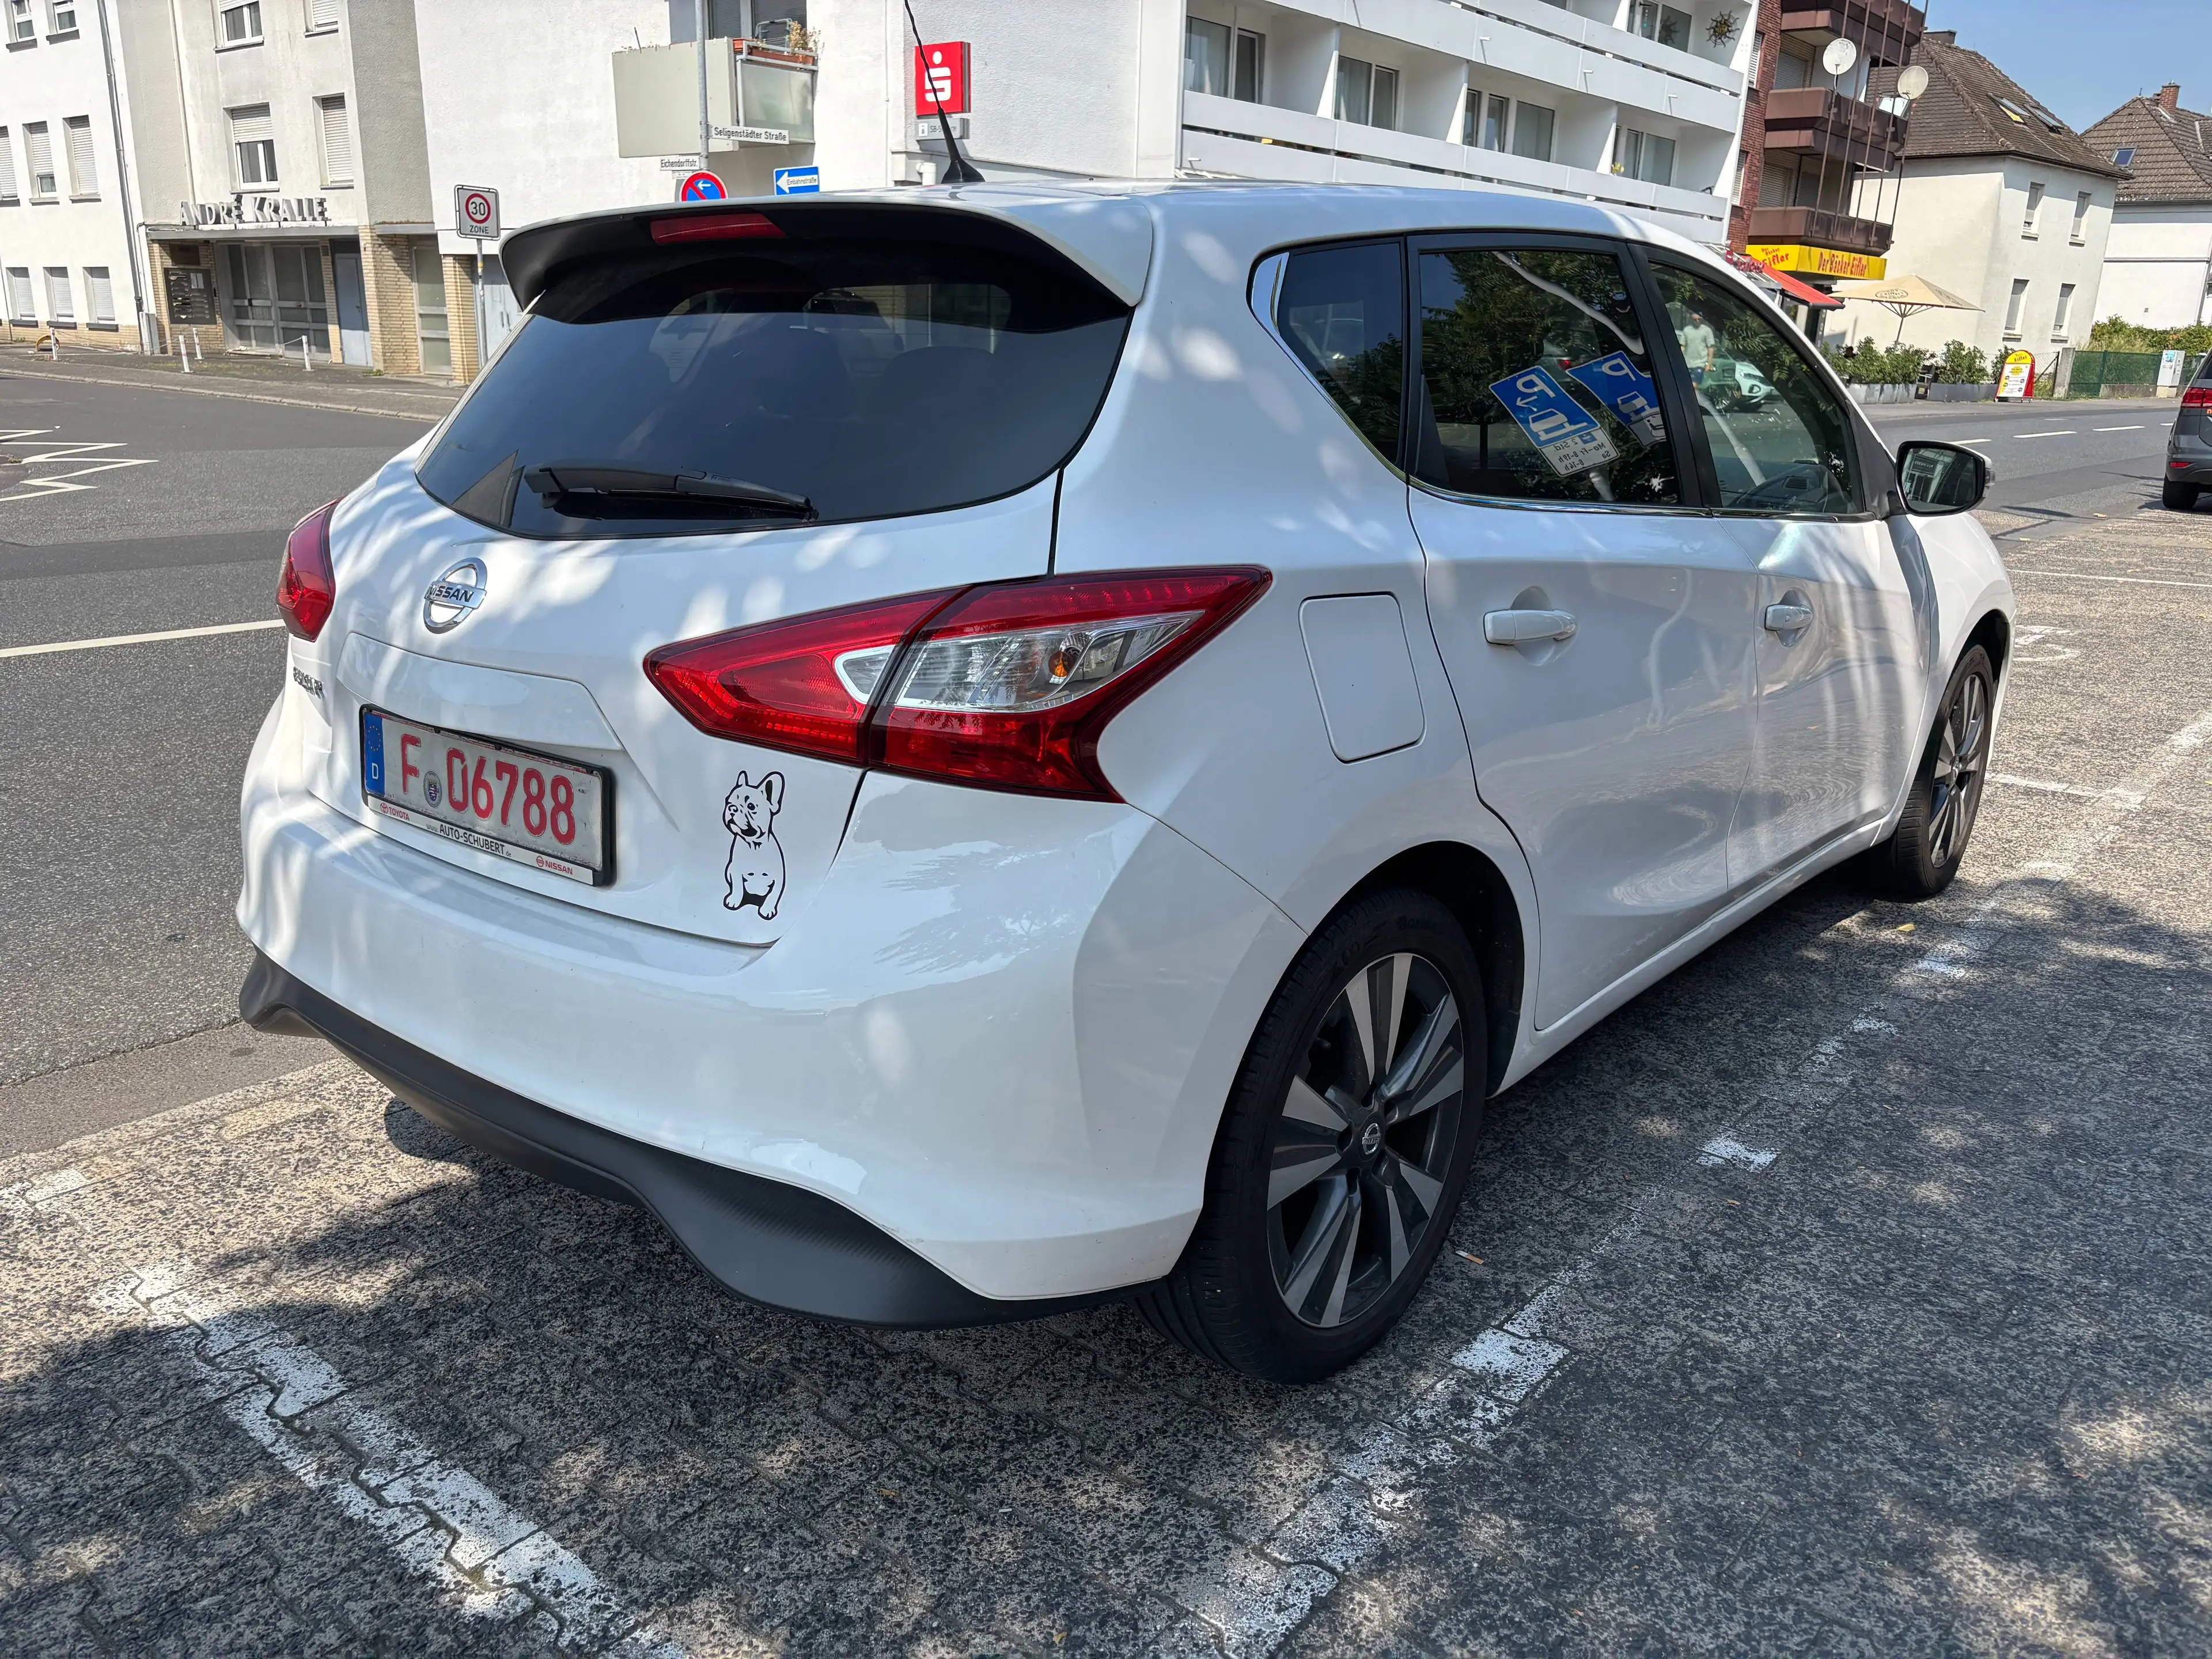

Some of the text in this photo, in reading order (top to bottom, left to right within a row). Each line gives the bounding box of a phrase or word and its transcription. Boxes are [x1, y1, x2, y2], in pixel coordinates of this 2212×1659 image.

[714, 127, 787, 141] Seligenstädter Straße
[252, 196, 332, 223] KRALLE
[470, 201, 486, 216] 30
[469, 225, 489, 234] ZONE
[1818, 252, 1830, 272] Der
[428, 584, 474, 603] NISSAN
[372, 763, 378, 780] D
[400, 733, 576, 846] F 06788
[389, 806, 410, 821] TOYOTA
[546, 859, 573, 875] NISSAN
